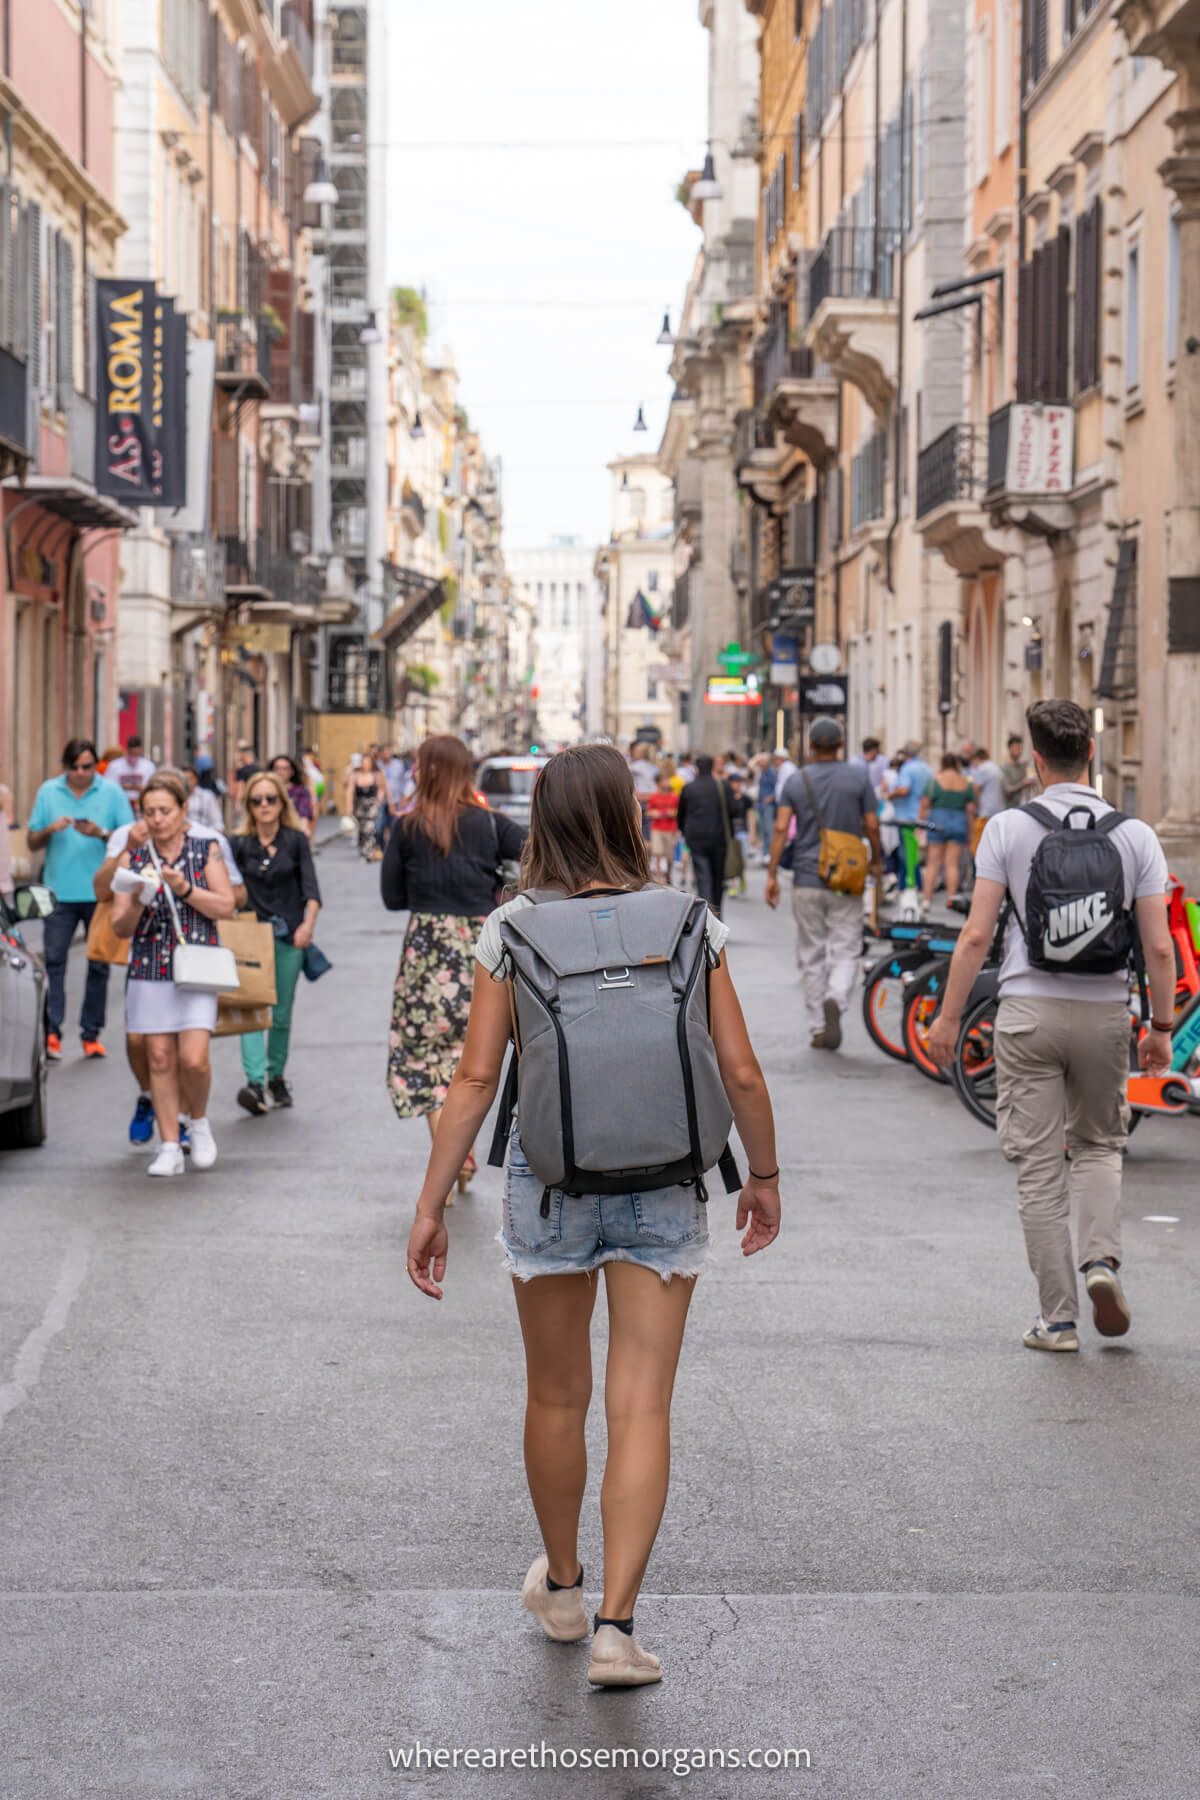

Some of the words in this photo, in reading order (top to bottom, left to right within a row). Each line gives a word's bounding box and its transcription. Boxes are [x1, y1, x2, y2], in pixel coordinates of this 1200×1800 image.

[107, 289, 143, 415] ROMA
[1045, 411, 1065, 489] PIZZA
[1048, 891, 1107, 942] NIKE
